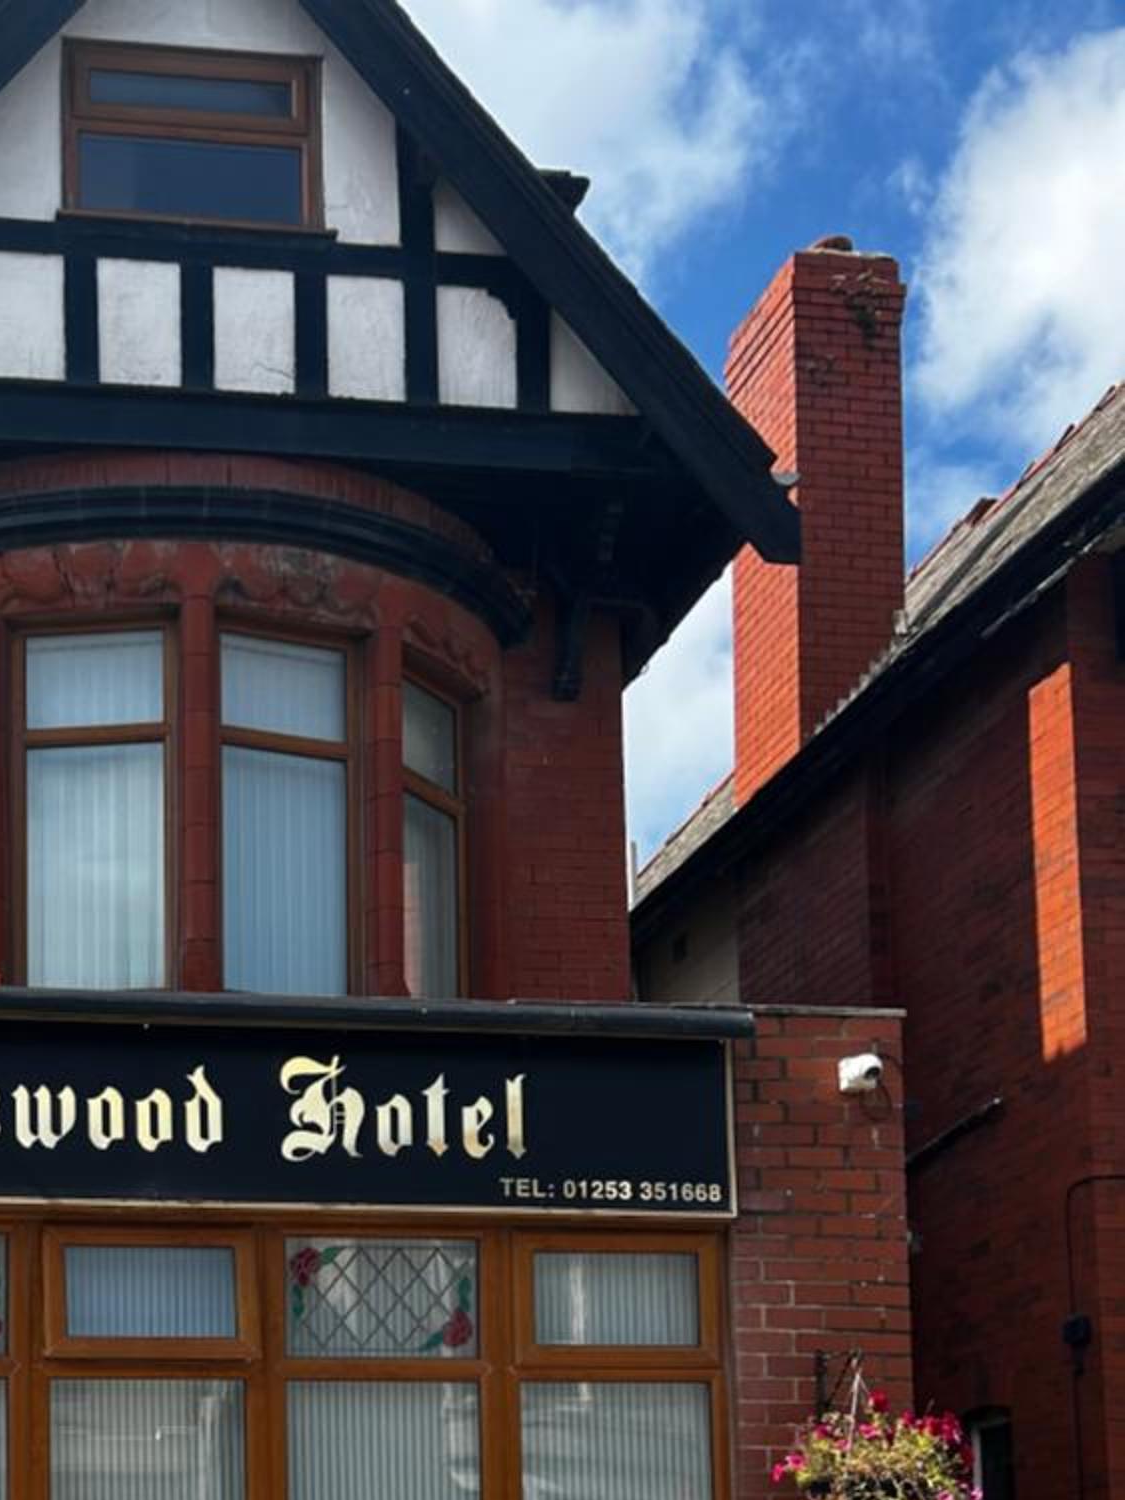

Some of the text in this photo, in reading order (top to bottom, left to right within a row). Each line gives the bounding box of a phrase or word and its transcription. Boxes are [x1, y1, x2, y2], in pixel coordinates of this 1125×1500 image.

[279, 1055, 527, 1162] Hotel
[500, 1177, 722, 1203] TEL: 01253 351668
